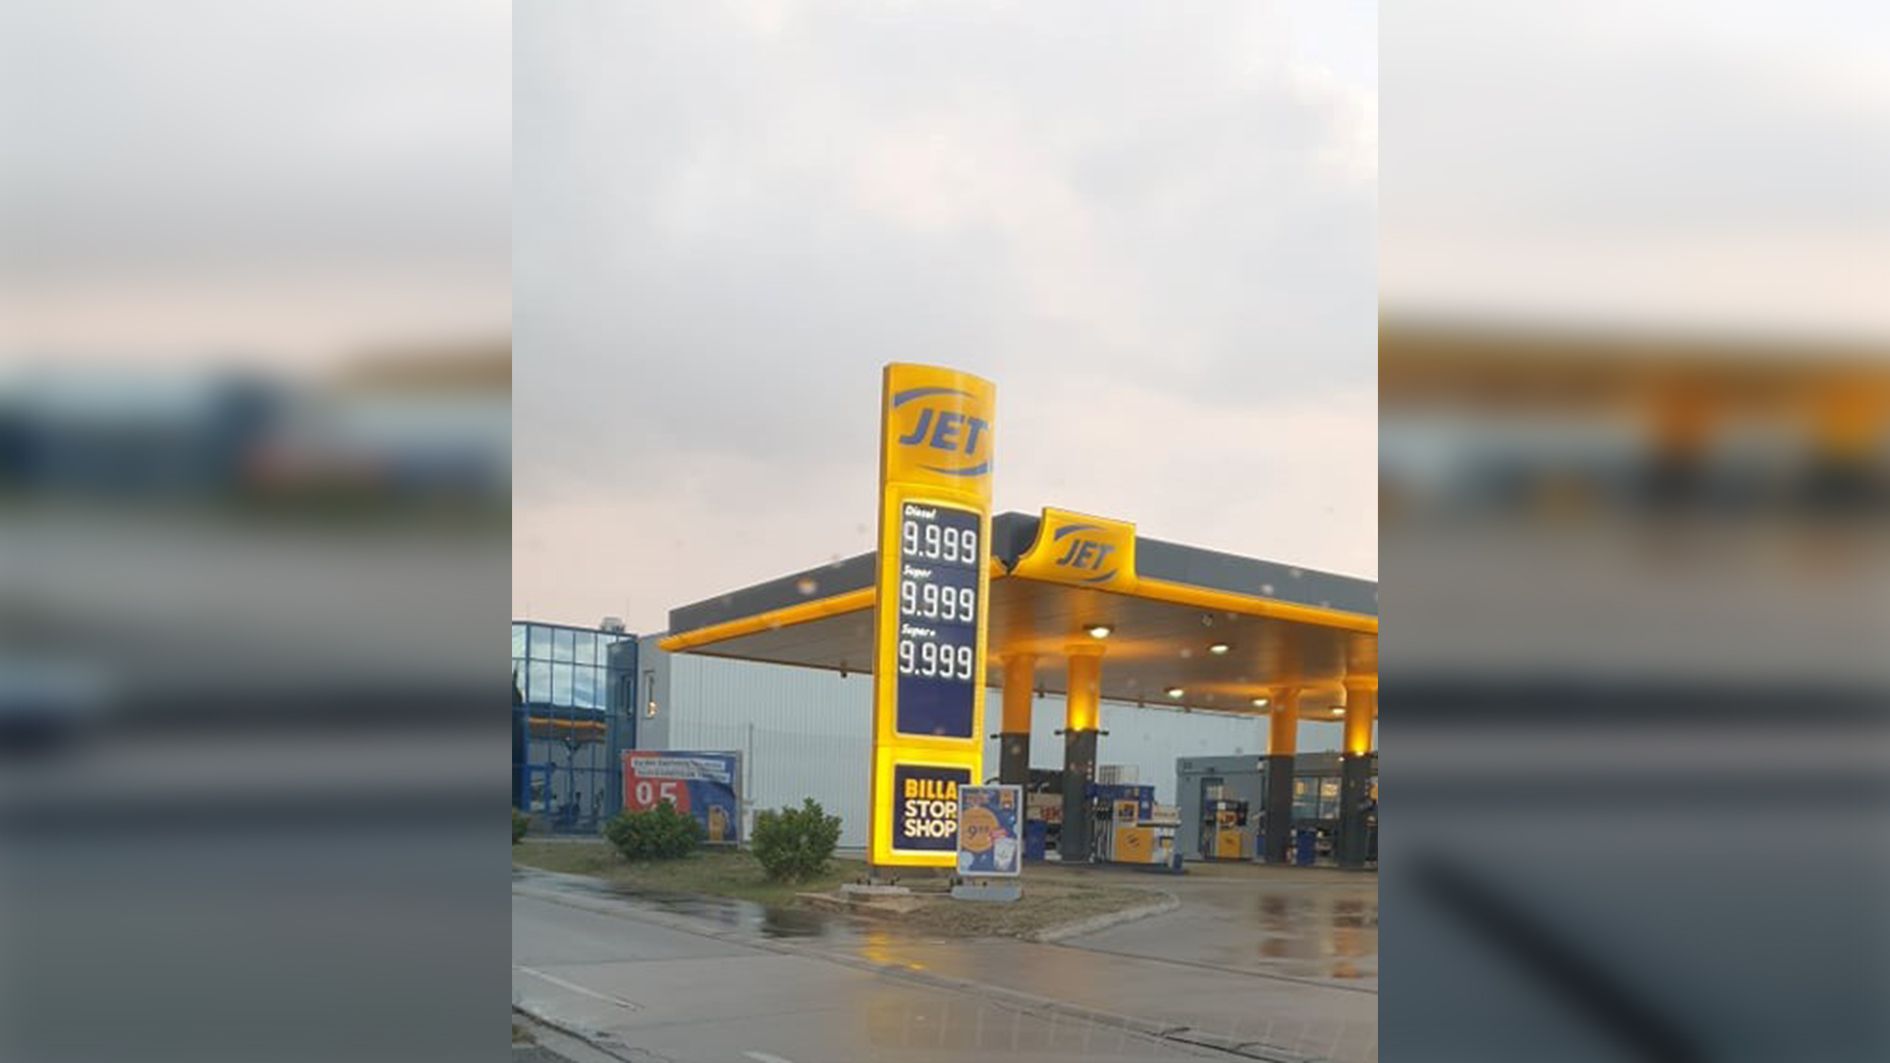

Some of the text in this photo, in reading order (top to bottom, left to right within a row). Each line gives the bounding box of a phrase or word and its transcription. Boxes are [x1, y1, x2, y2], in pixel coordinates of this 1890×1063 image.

[899, 408, 988, 455] JET
[903, 520, 977, 564] 9.999
[1056, 538, 1116, 571] JET
[902, 580, 975, 623] 9.999
[899, 640, 973, 680] 9.999
[904, 778, 957, 799] BILLA
[904, 818, 957, 838] SHOP
